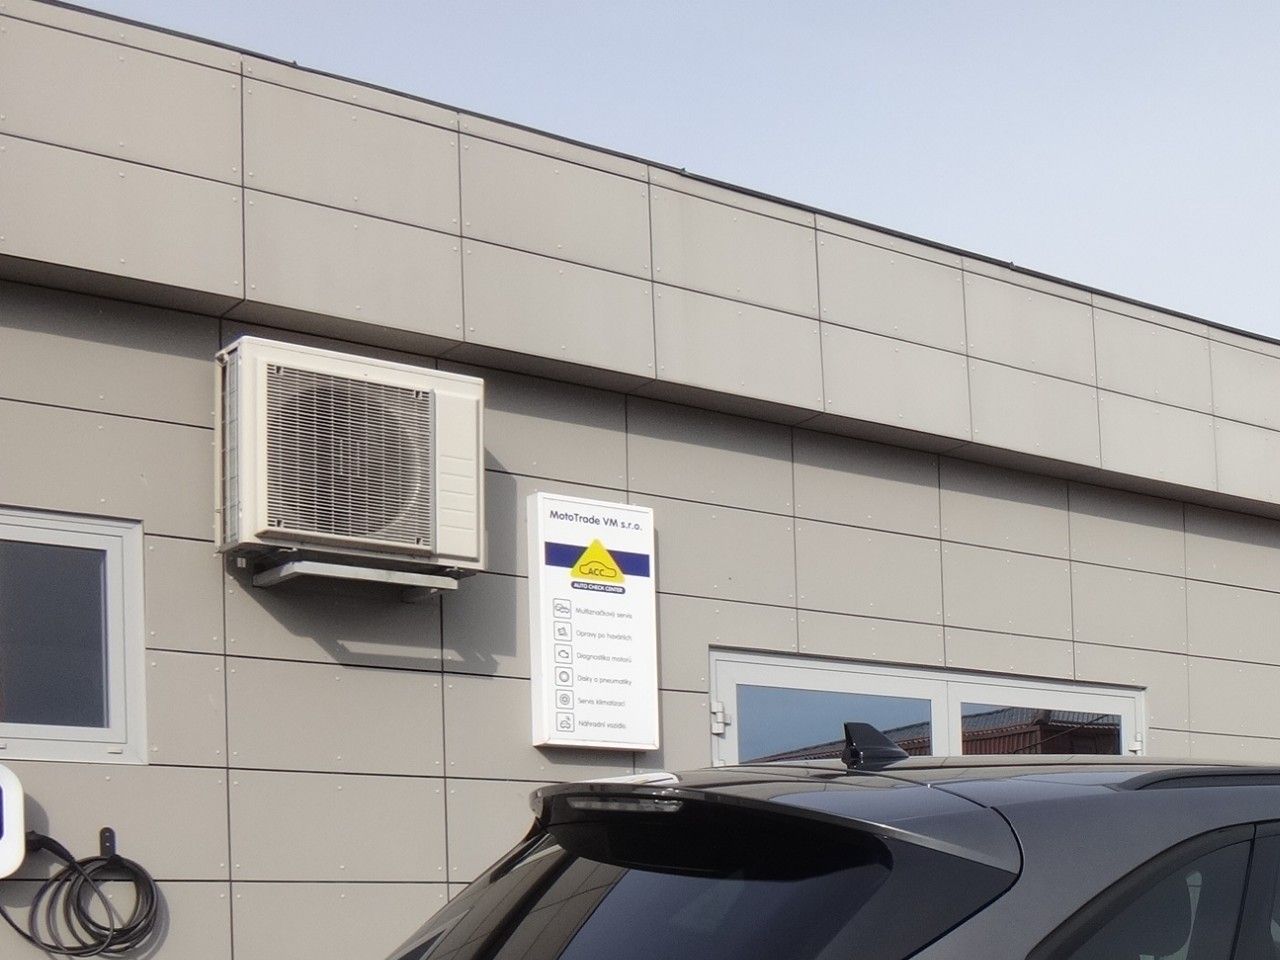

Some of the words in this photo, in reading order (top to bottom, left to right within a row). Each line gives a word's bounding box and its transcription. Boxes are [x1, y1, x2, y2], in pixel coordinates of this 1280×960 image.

[549, 510, 600, 526] MotoTrade
[602, 517, 618, 528] VM
[621, 521, 643, 531] s.r.o.
[588, 568, 605, 577] ACC
